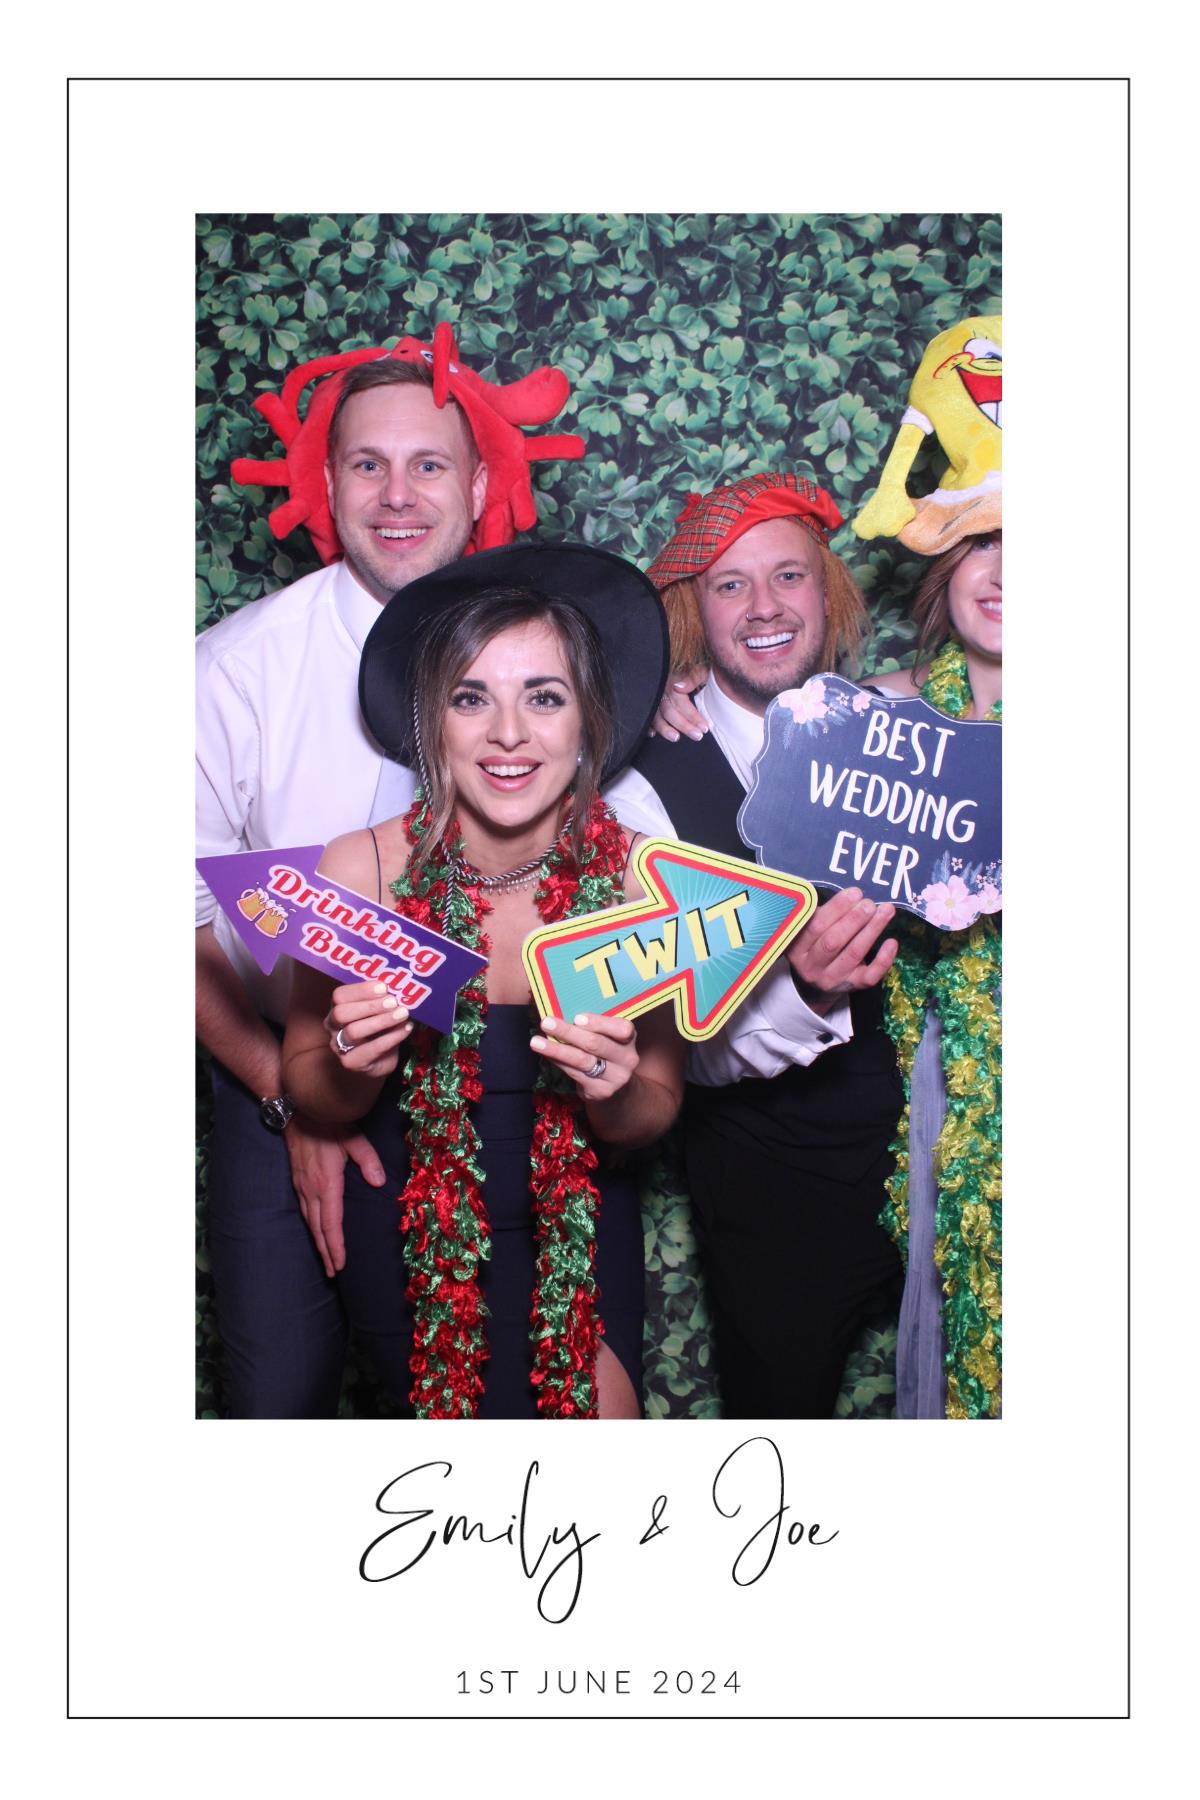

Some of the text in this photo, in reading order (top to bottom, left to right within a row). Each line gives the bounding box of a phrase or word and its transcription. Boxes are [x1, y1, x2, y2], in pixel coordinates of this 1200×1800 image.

[862, 710, 956, 778] BEST
[810, 760, 979, 843] WEDDING
[828, 830, 920, 901] EVER
[270, 866, 443, 975] Drinking
[572, 890, 750, 999] TWIT
[302, 924, 430, 1008] Buddy
